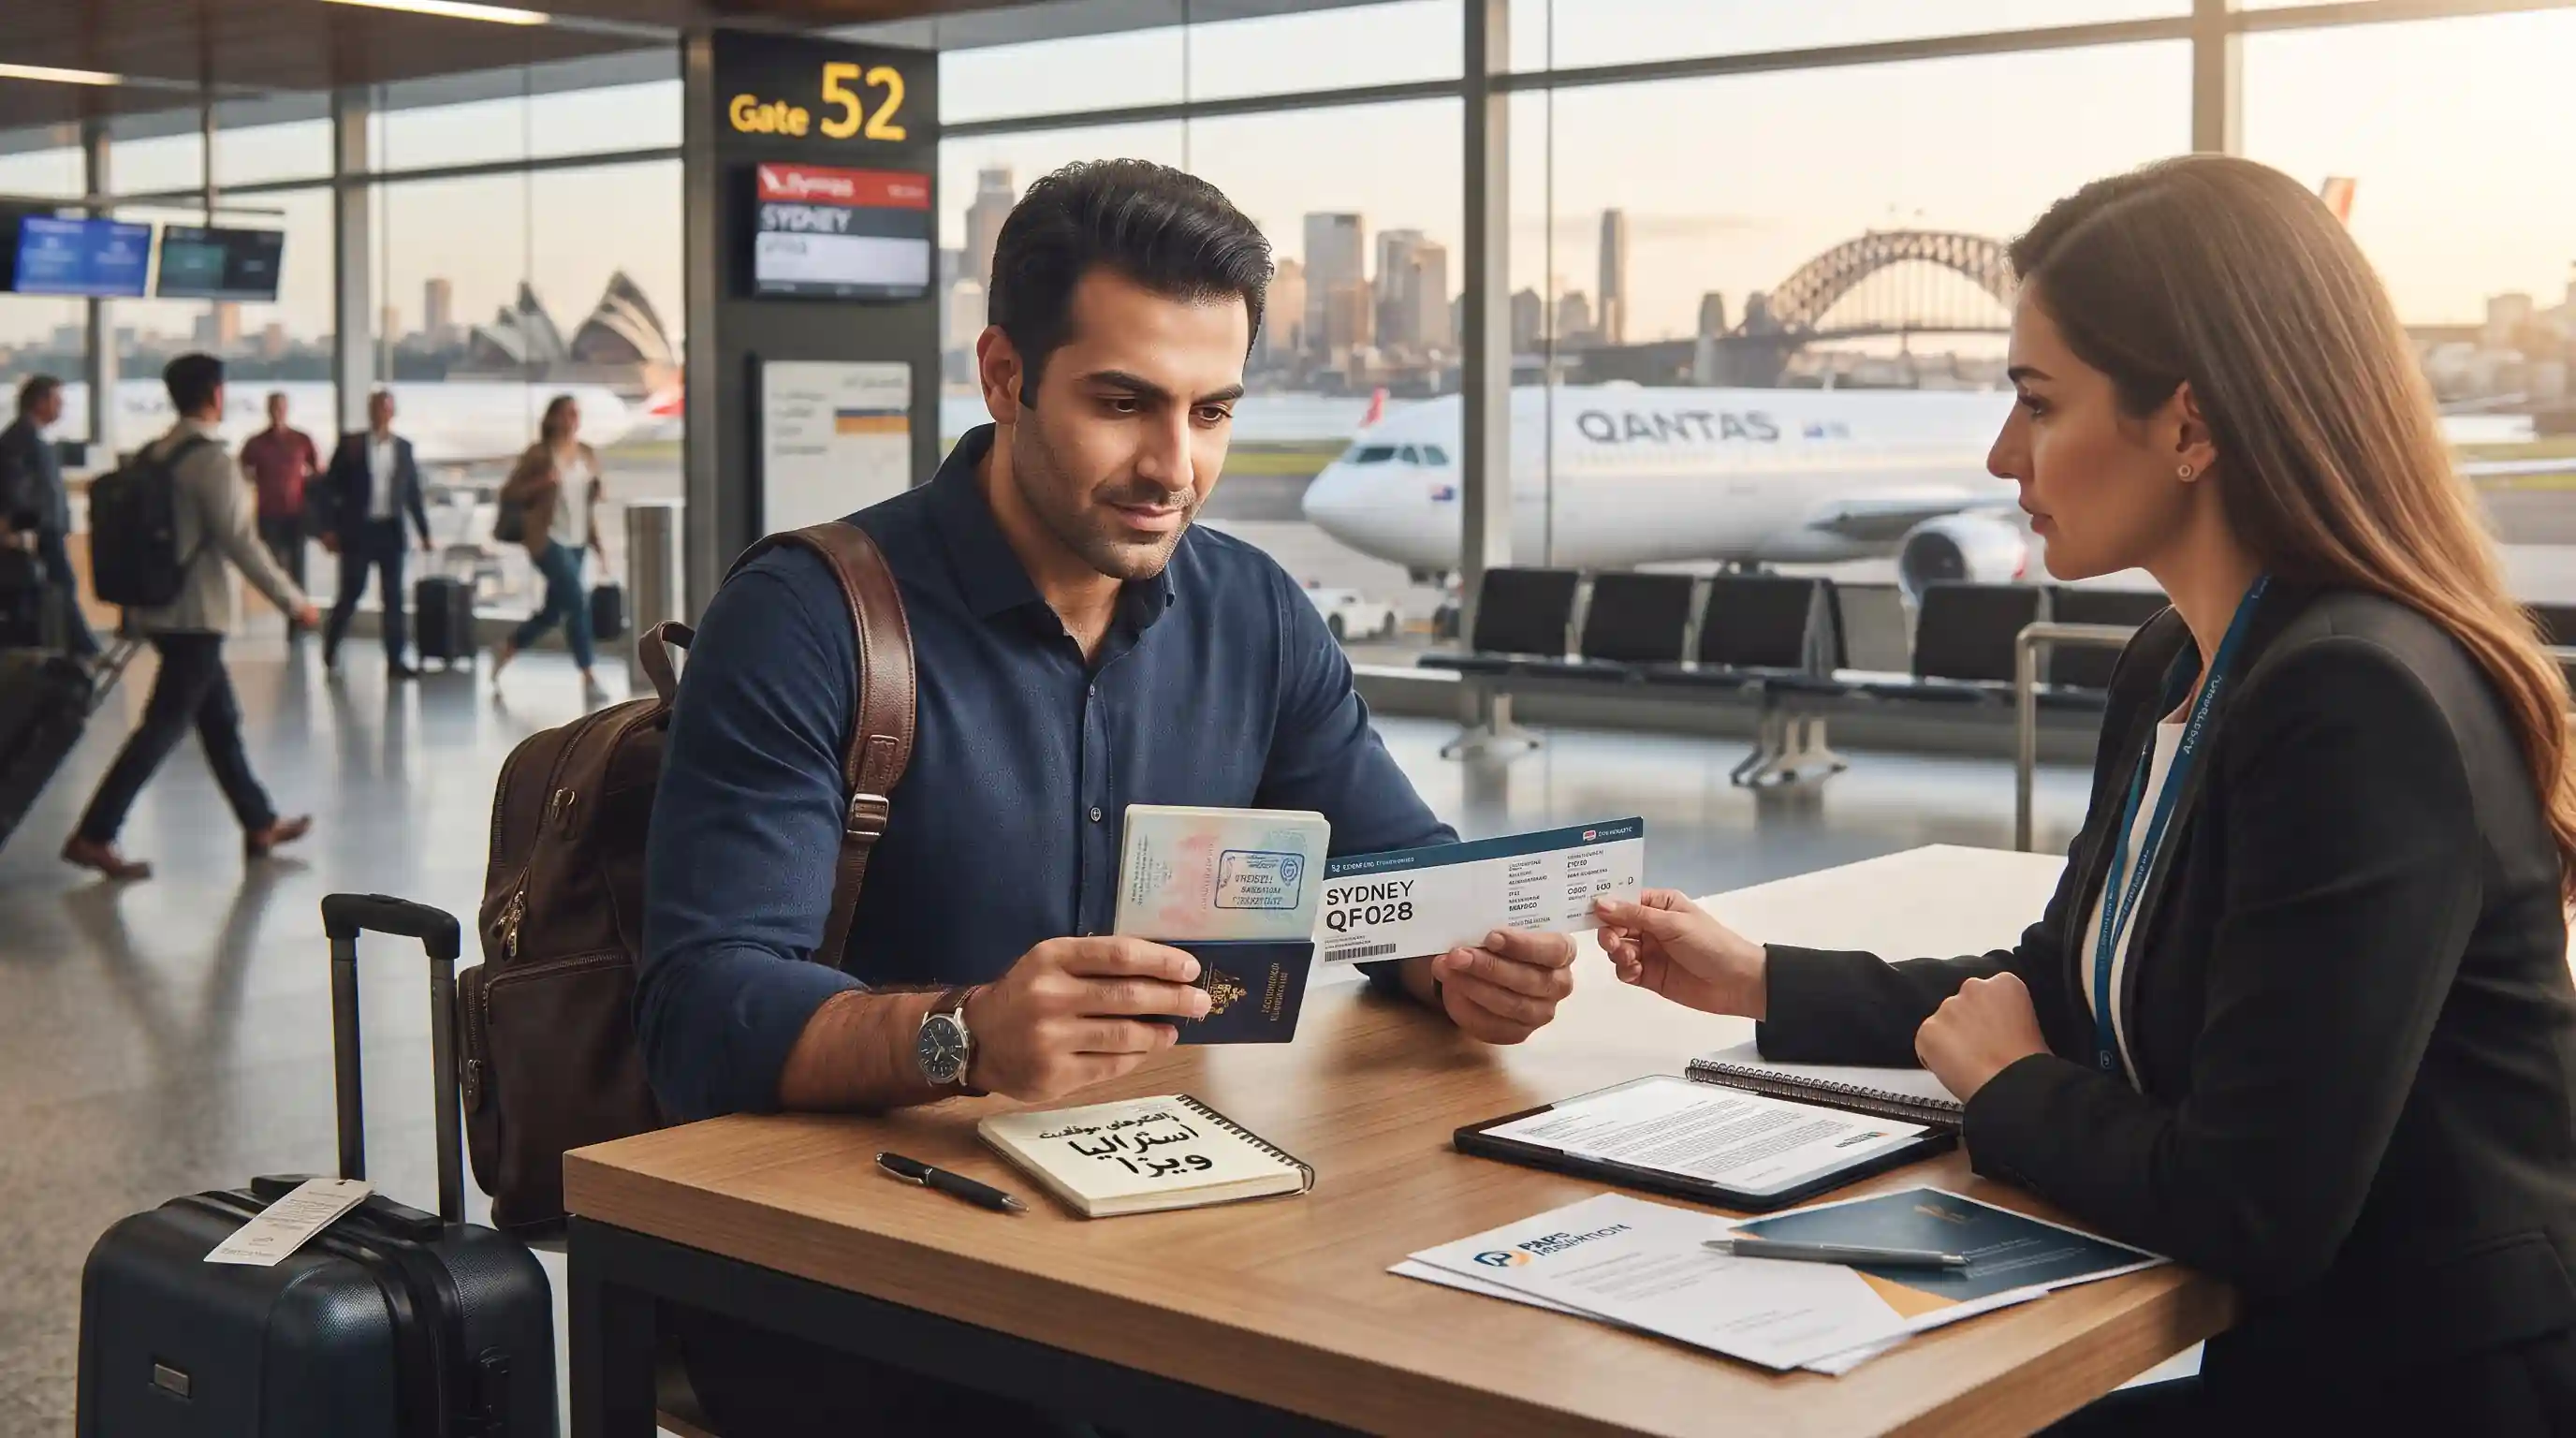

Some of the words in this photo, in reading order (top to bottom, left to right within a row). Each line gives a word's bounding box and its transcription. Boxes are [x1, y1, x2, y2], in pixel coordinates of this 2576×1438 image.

[729, 94, 810, 137] Gate
[820, 61, 907, 141] 52
[1575, 409, 1779, 445] QANTAS
[1325, 879, 1414, 906] SYDNEY
[1325, 901, 1414, 933] QF028
